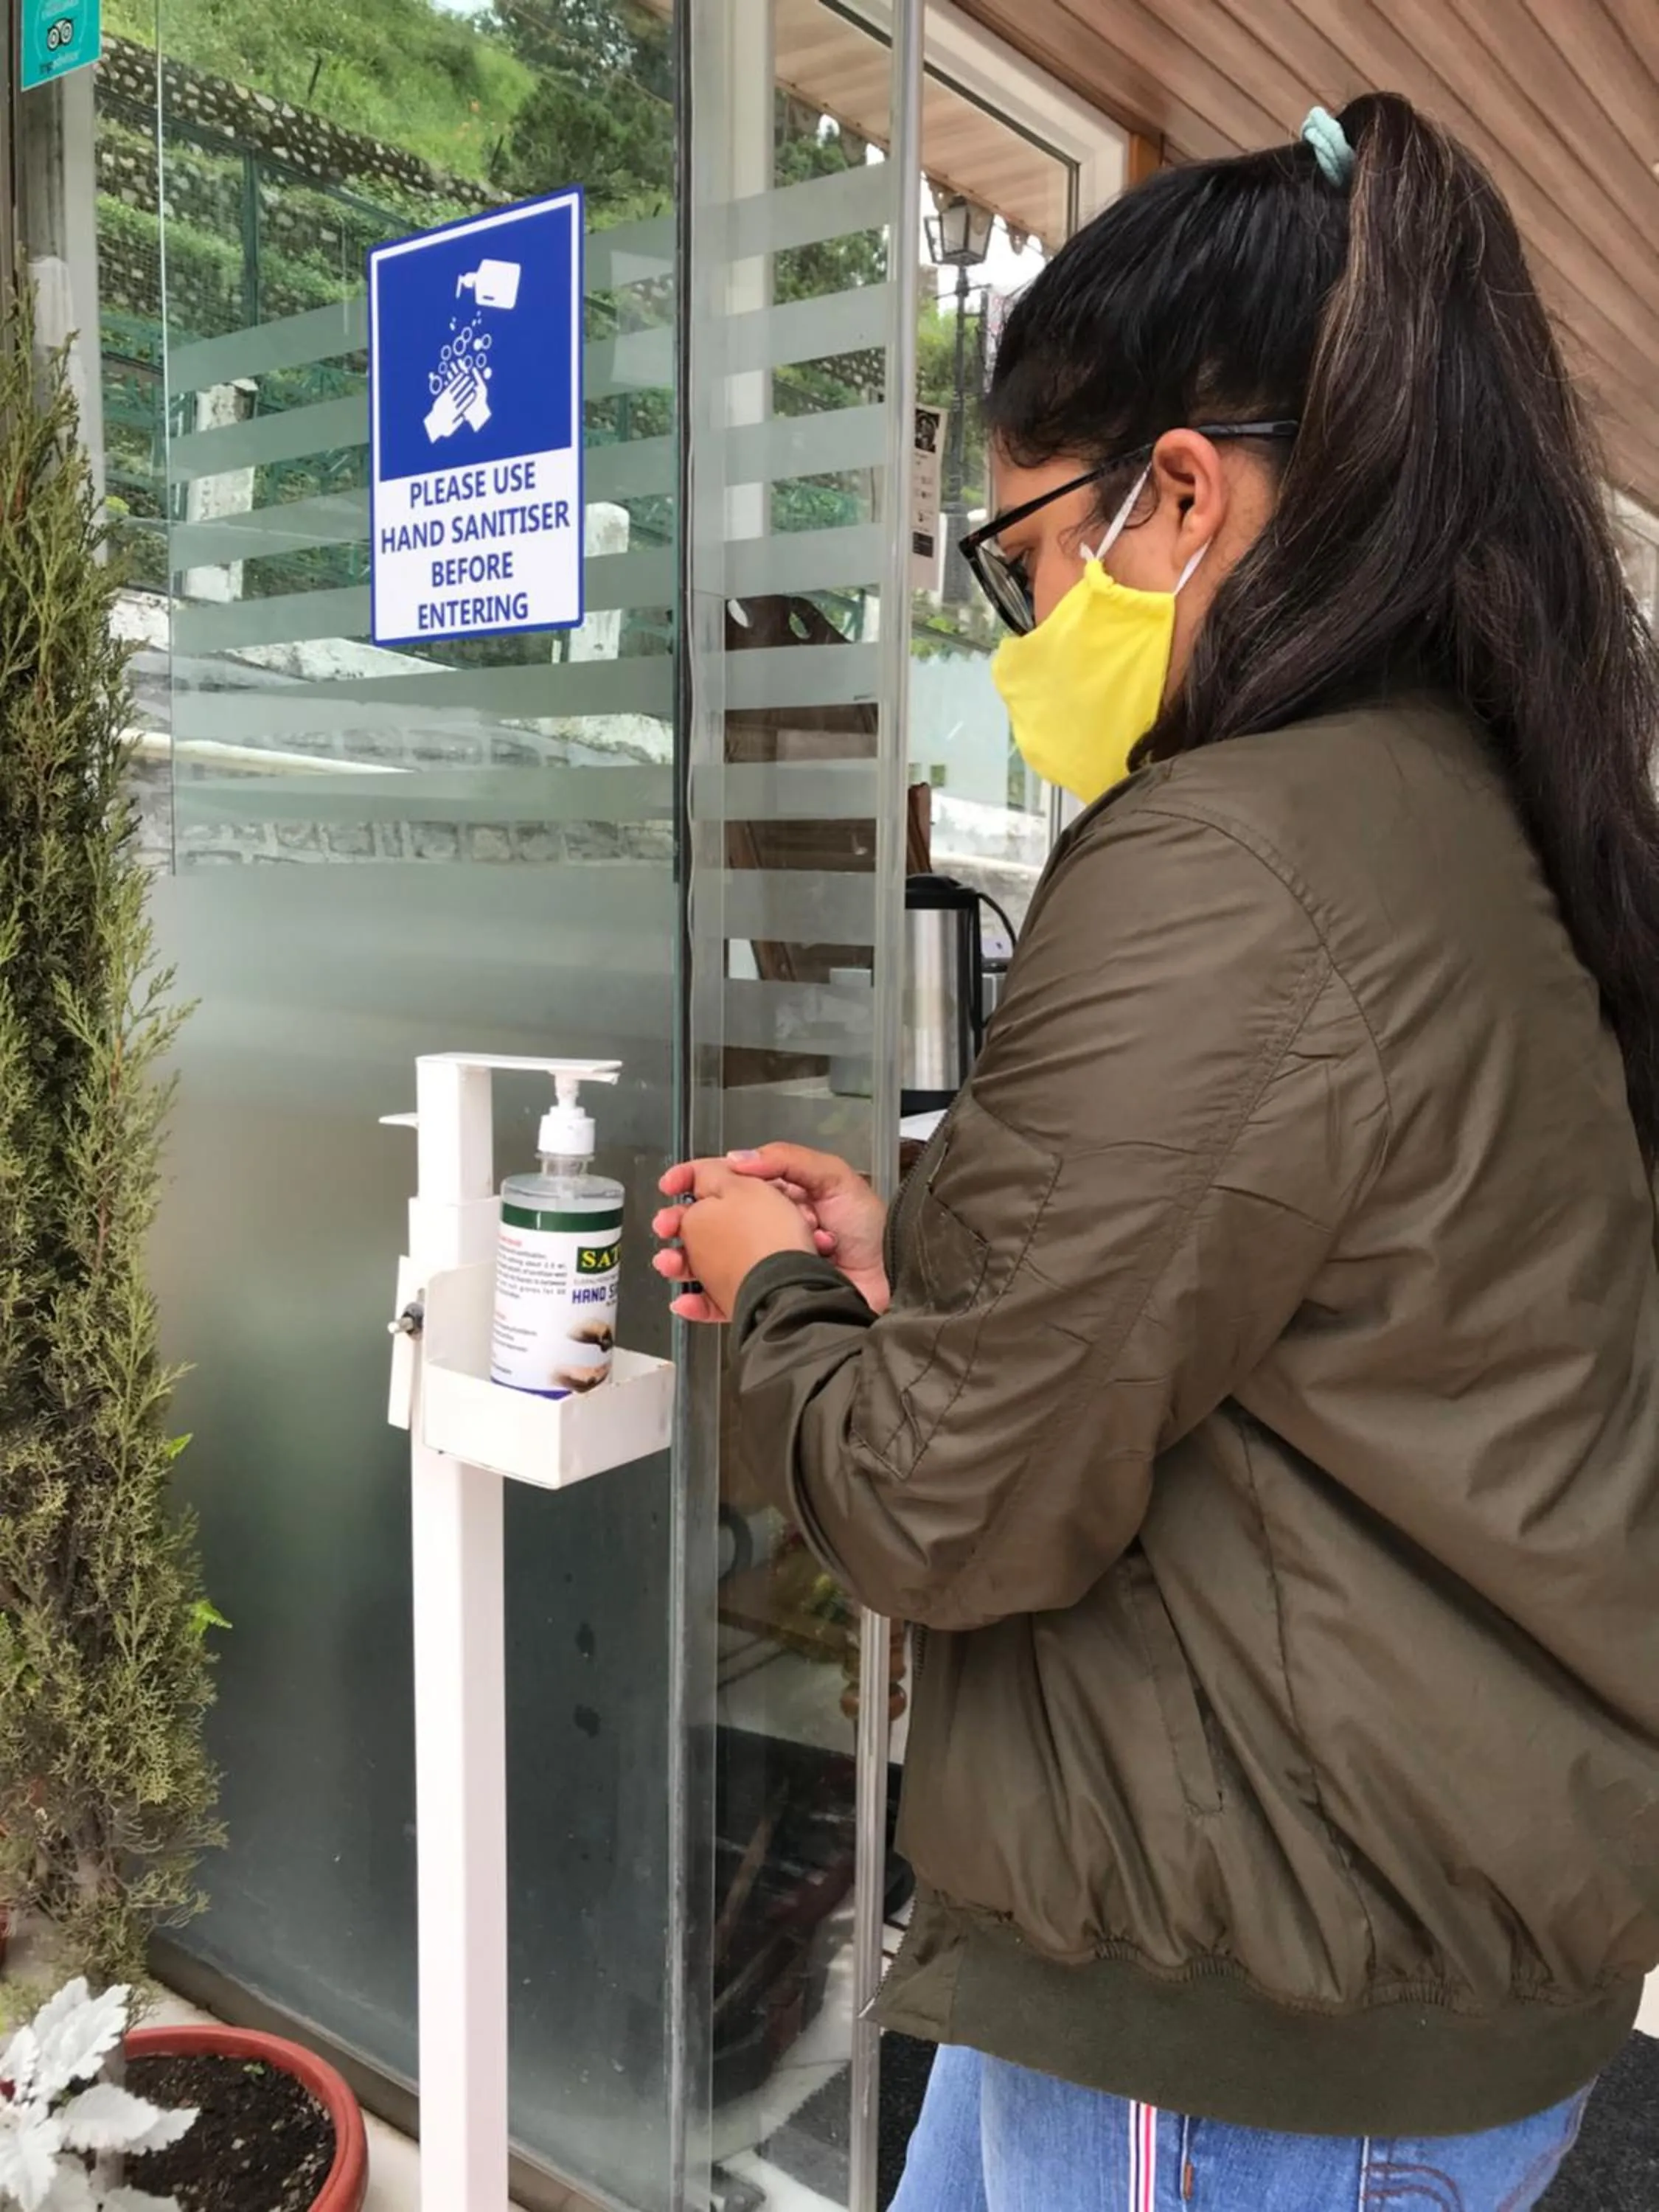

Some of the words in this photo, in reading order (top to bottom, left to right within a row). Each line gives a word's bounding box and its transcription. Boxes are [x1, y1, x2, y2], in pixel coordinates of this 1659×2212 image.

[410, 470, 487, 509] PLEASE
[493, 462, 536, 495] USE
[381, 520, 445, 554] HAND
[451, 501, 571, 543] SANITISER
[432, 552, 514, 588] BEFORE
[418, 592, 529, 630] ENTERING
[571, 1286, 606, 1304] HAND
